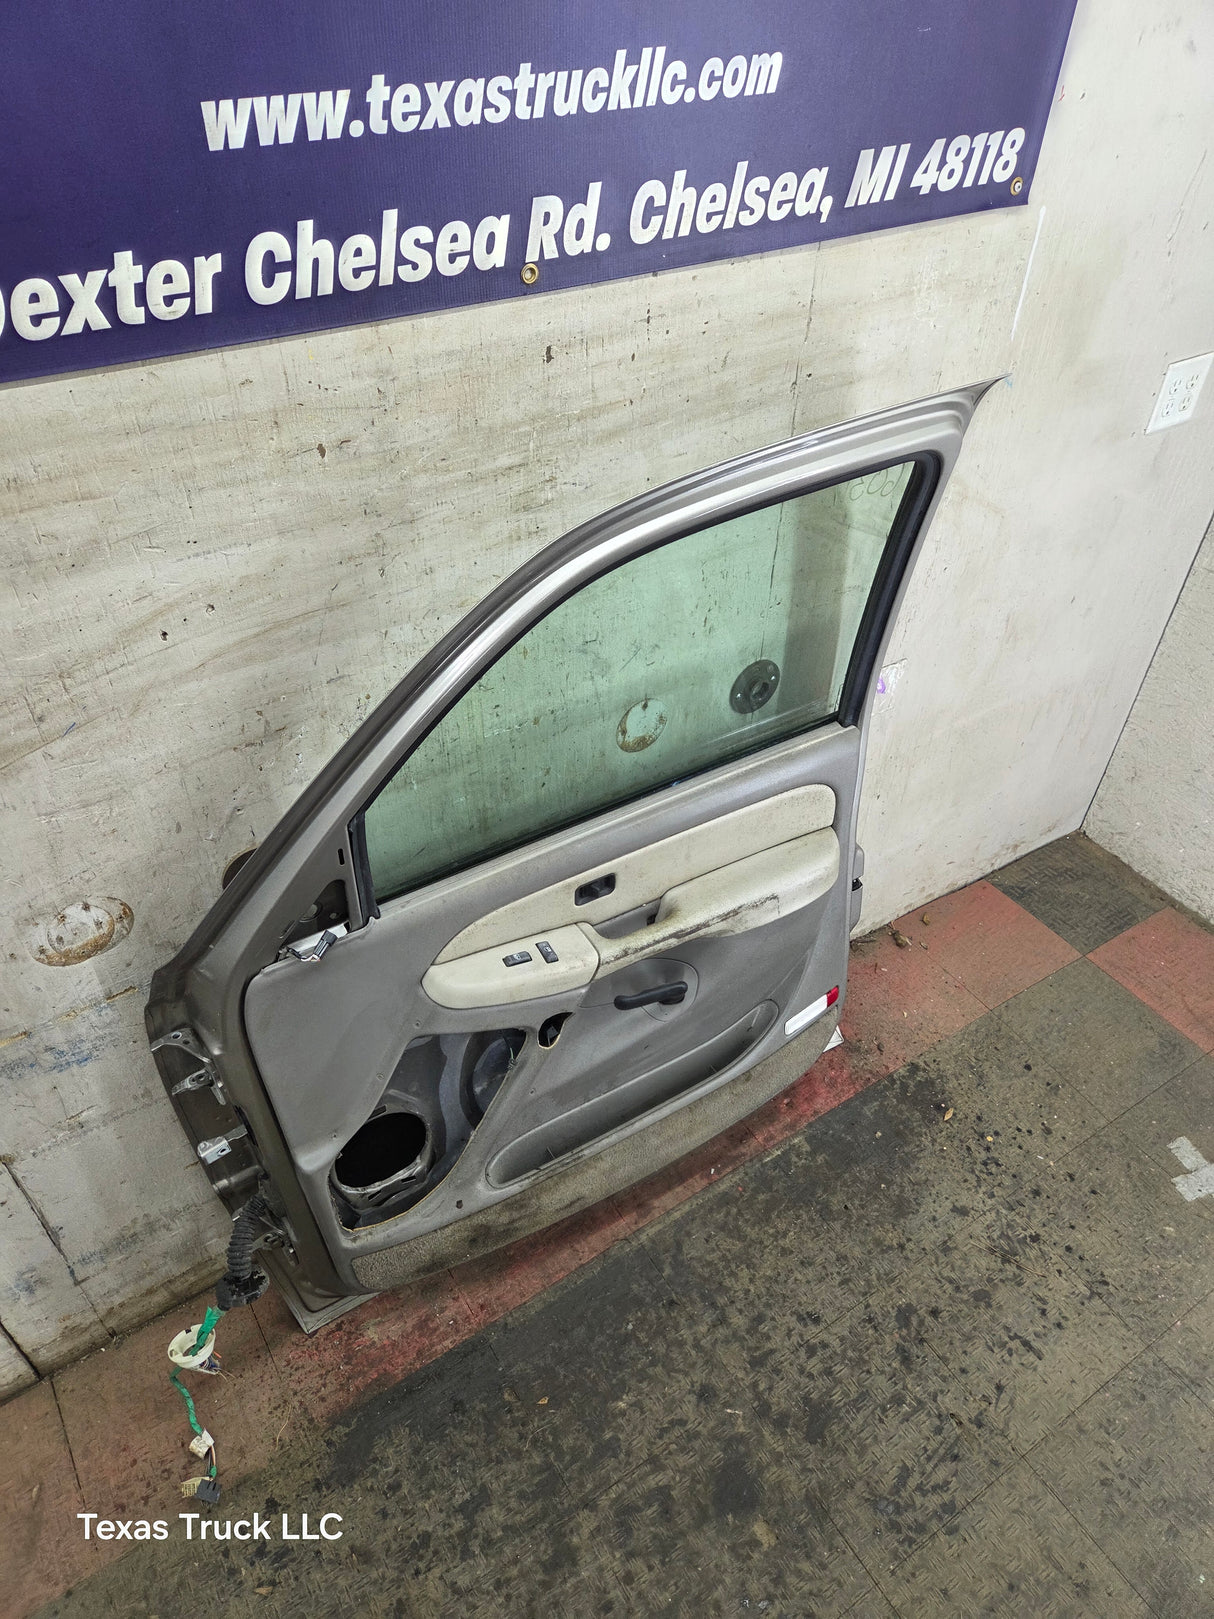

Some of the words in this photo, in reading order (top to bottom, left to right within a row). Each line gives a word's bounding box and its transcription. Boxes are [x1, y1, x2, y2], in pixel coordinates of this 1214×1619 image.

[200, 45, 784, 152] www.texastruckllc.com
[0, 250, 222, 341] exter
[244, 208, 511, 306] Chelsea
[524, 180, 612, 264] Rd.
[629, 159, 834, 245] Chelsea,
[843, 142, 912, 209] MI
[910, 127, 1026, 196] 48118
